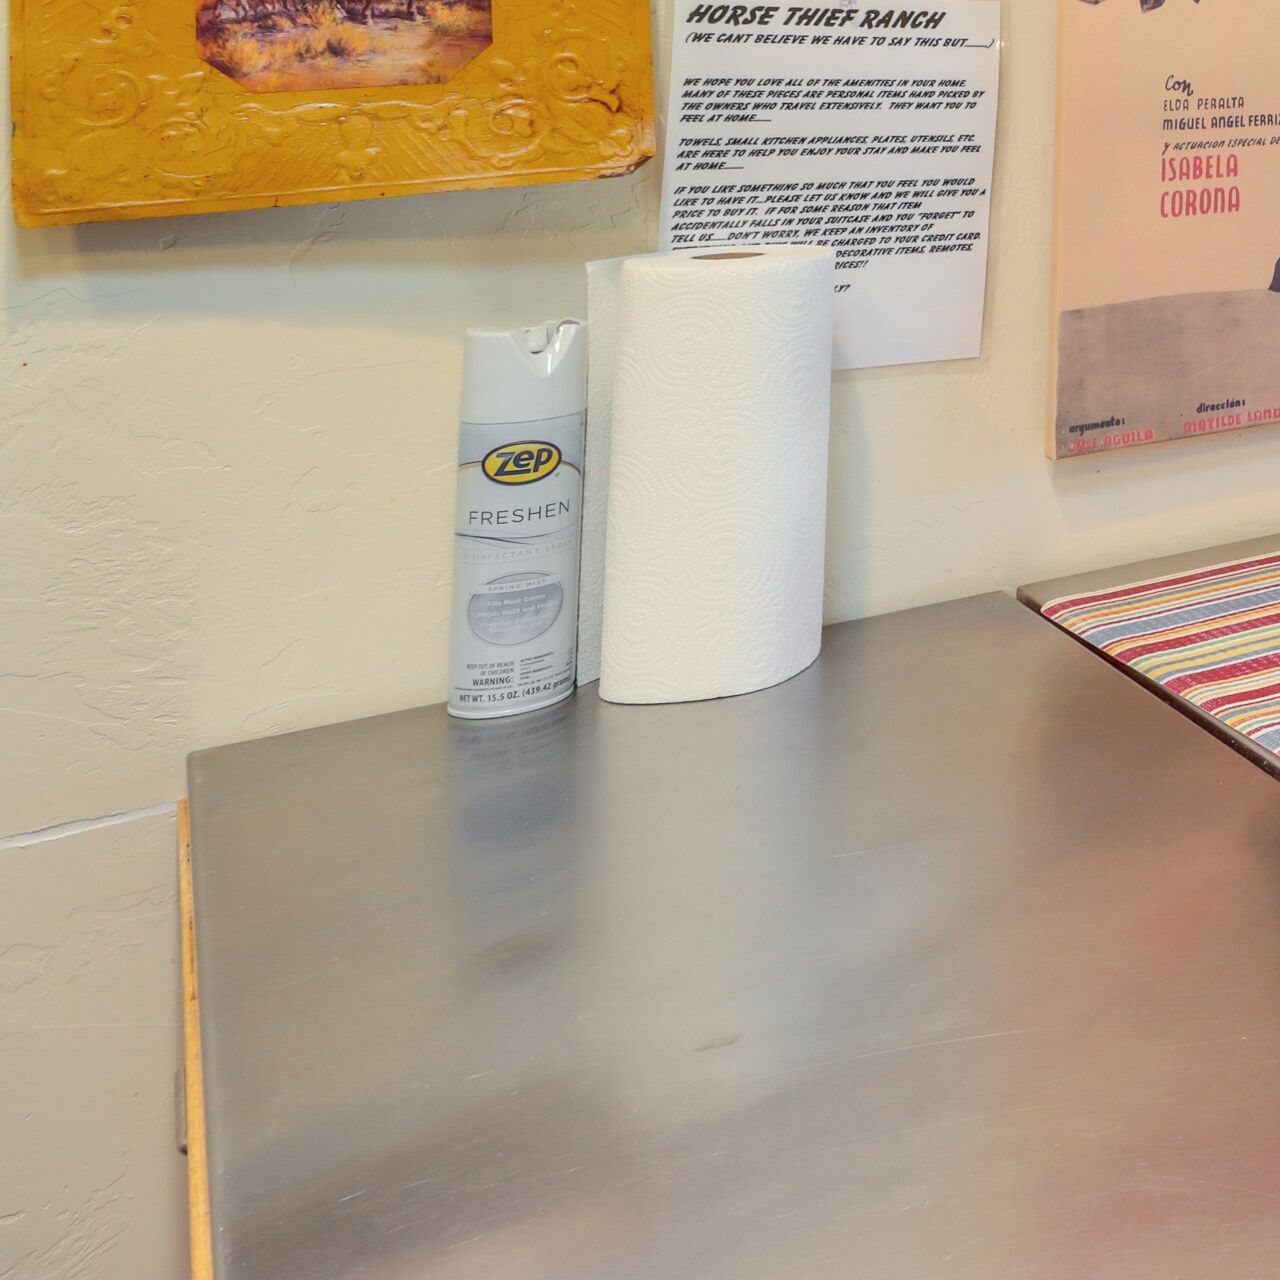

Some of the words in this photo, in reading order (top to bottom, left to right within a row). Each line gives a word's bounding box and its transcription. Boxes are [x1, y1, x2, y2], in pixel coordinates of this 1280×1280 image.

[686, 4, 780, 26] HORSE
[783, 7, 859, 27] THIEF
[859, 9, 947, 29] RANCH
[754, 34, 809, 44] BELIEVE
[811, 35, 832, 45] WE
[833, 36, 867, 46] HAVE
[870, 36, 886, 46] TO
[888, 37, 912, 47] SAY
[914, 37, 941, 47] THIS
[683, 78, 701, 87] WE
[702, 78, 733, 87] HOPE
[734, 78, 756, 86] YOU
[757, 79, 784, 87] LOVE
[784, 79, 804, 87] ALL
[806, 79, 822, 87] OF
[823, 79, 842, 87] THE
[843, 79, 896, 87] AMENITIES
[1165, 75, 1194, 96] Con
[681, 90, 715, 98] MANY
[716, 90, 731, 98] OF
[732, 90, 765, 98] THESE
[766, 90, 801, 98] PIECES
[802, 90, 824, 98] ARE
[825, 90, 875, 98] PERSONAL
[876, 90, 908, 98] ITEMS
[909, 90, 936, 98] HAND
[681, 102, 703, 110] THE
[704, 102, 751, 110] OWNERS
[752, 102, 777, 110] WHO
[779, 102, 817, 110] TRAVEL
[1163, 99, 1189, 111] ELDA
[1197, 97, 1245, 110] PERALTA
[680, 114, 704, 122] FEEL
[707, 114, 723, 122] AT
[1163, 117, 1206, 130] MIGUEL
[1211, 116, 1246, 129] ANGEL
[725, 137, 760, 146] SMALL
[761, 137, 806, 145] KITCHEN
[1228, 137, 1267, 148] ESPECIAL
[676, 150, 700, 159] ARE
[701, 150, 731, 158] HERE
[732, 149, 747, 157] TO
[747, 149, 776, 157] HELP
[777, 148, 800, 156] YOU
[800, 148, 833, 156] ENJOY
[862, 147, 887, 155] STAY
[909, 146, 939, 154] MAKE
[960, 145, 982, 153] FEEL
[675, 163, 692, 171] AT
[1161, 153, 1238, 182] ISABELA
[1160, 186, 1240, 218] CORONA
[748, 219, 780, 228] FALLS
[781, 218, 794, 226] IN
[797, 217, 824, 225] YOUR
[824, 215, 871, 225] SUITCASE
[872, 214, 893, 222] AND
[896, 213, 915, 221] YOU
[836, 247, 894, 258] DECORATIVE
[1184, 413, 1242, 435] MATILDE
[1103, 428, 1154, 447] AGUILA
[469, 499, 570, 525] FRESHEN
[487, 668, 514, 676] CHILDREN
[472, 676, 514, 686] WARNING:
[487, 693, 505, 702] 15.5
